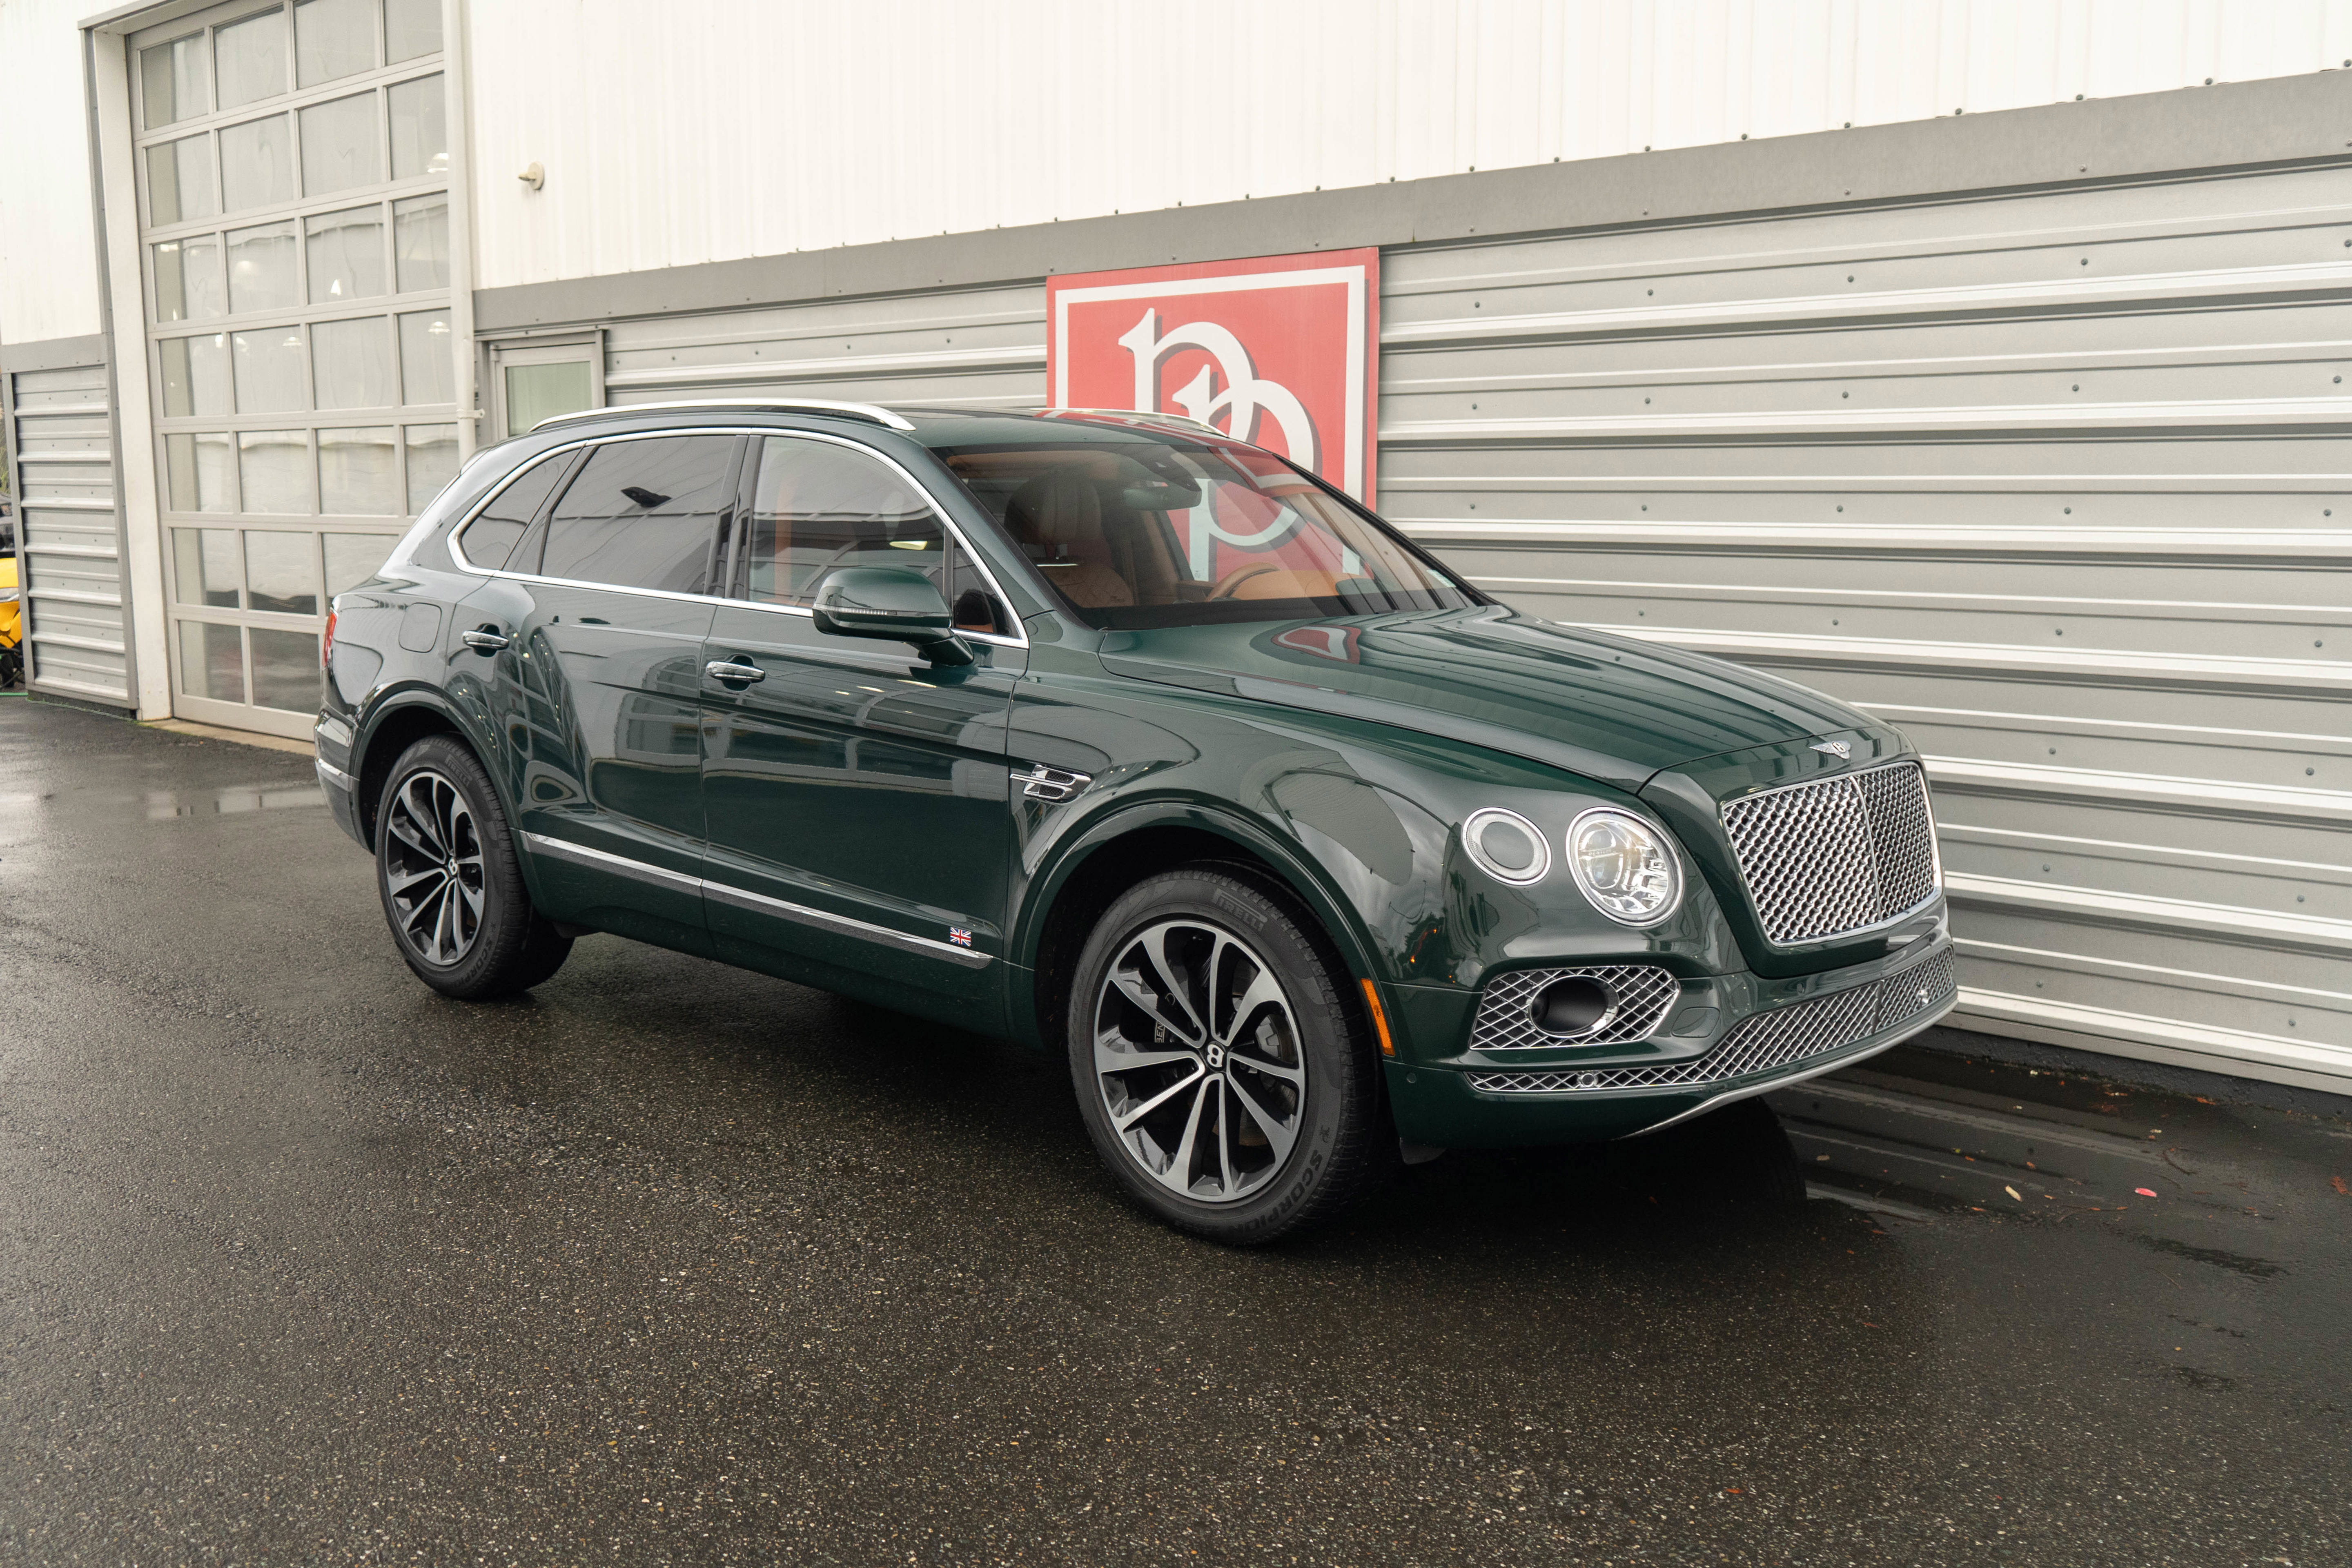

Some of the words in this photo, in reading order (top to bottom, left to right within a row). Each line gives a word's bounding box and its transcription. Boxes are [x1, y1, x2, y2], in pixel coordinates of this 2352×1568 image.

[445, 754, 473, 787] PIRELLI
[1211, 887, 1268, 932] PIRELLI
[457, 936, 492, 987] SCORPIO
[1207, 1044, 1225, 1067] B
